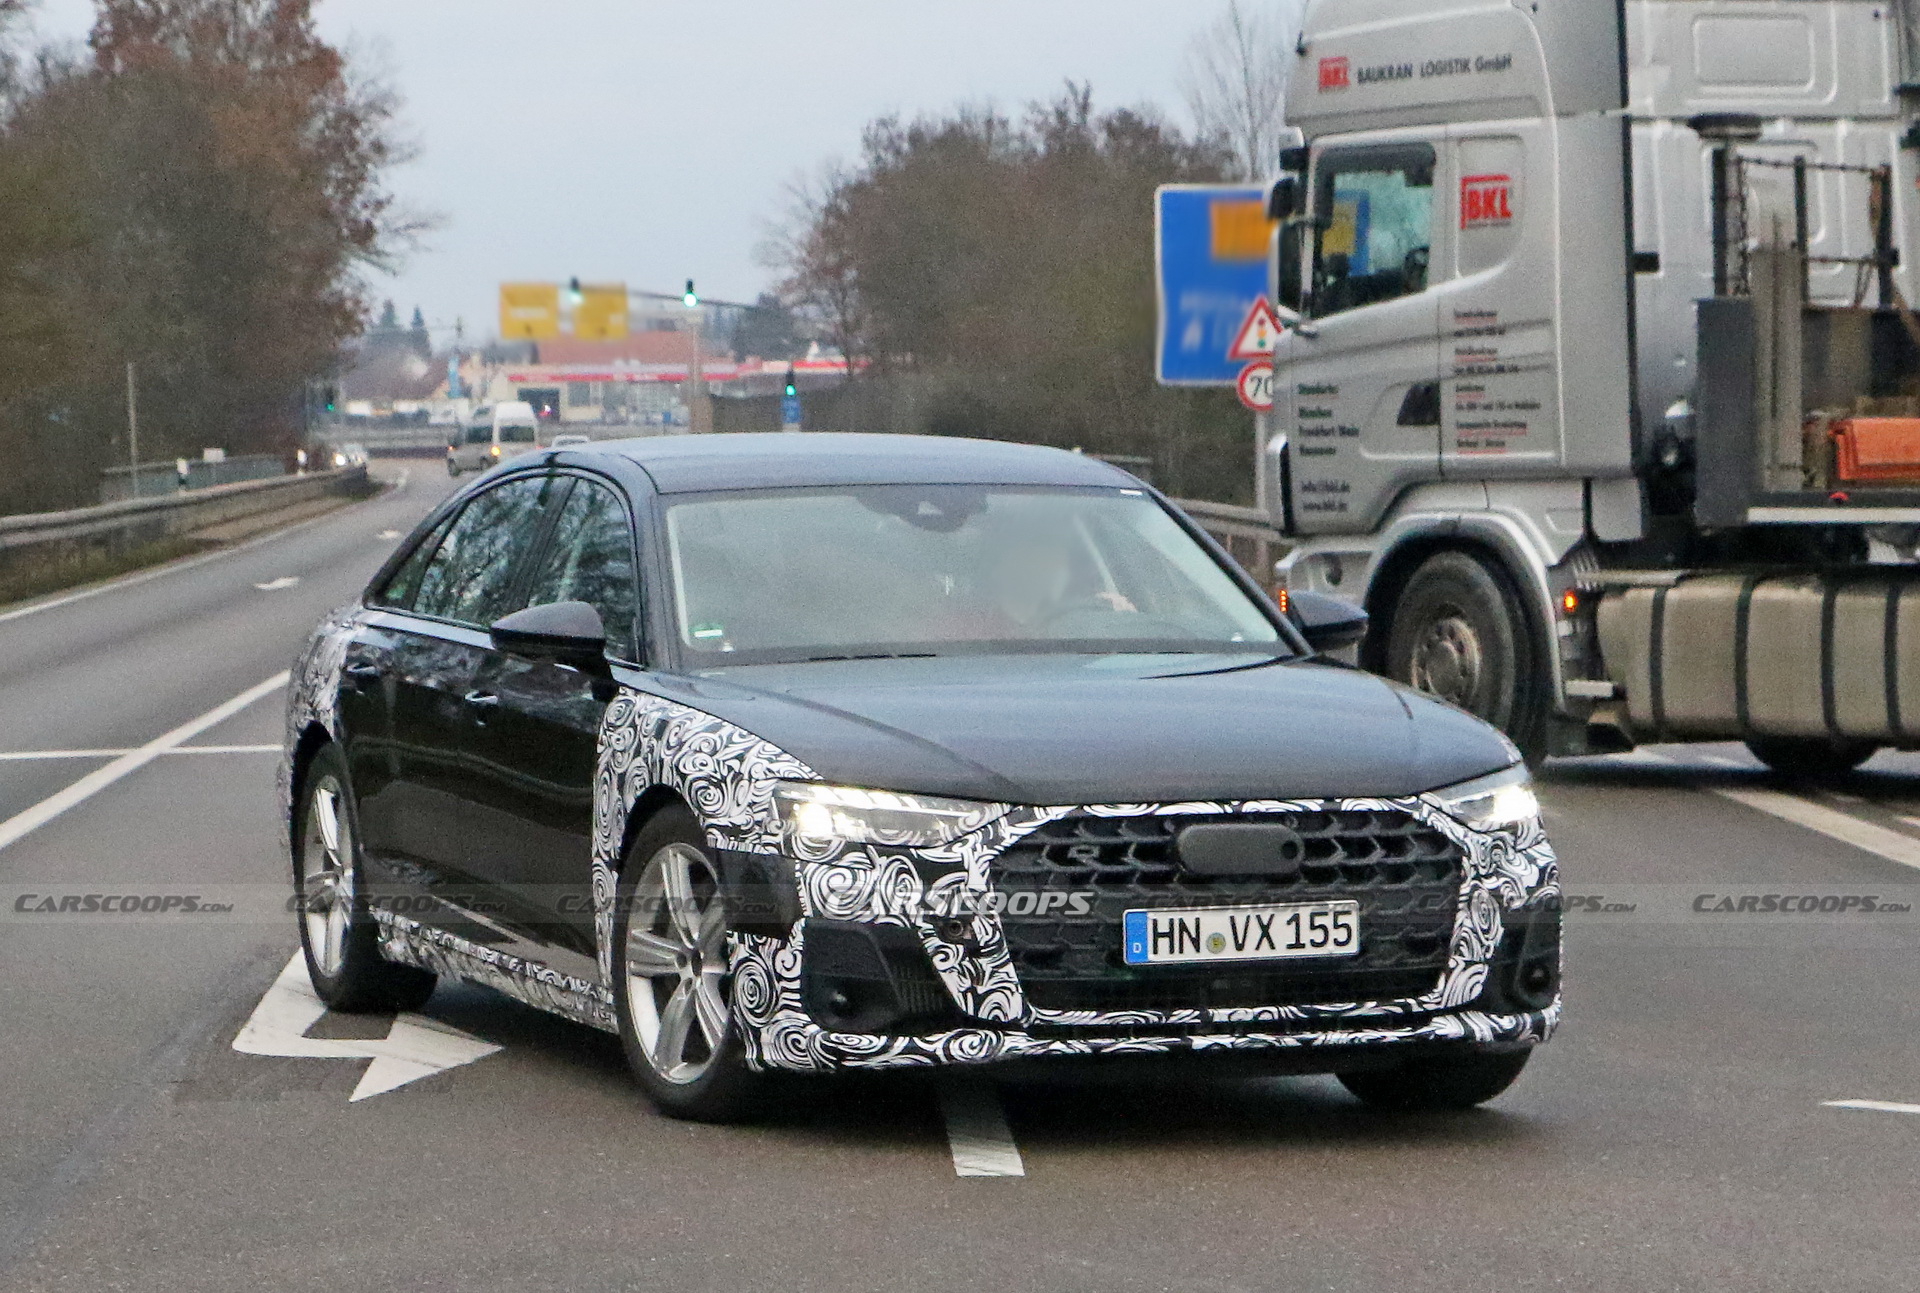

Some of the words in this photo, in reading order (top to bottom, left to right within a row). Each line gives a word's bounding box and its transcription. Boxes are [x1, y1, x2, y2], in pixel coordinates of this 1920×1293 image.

[1357, 63, 1413, 84] BAUKRAN
[1420, 57, 1470, 78] LOGISTIK
[1474, 53, 1512, 72] GmbH
[1467, 187, 1513, 219] BKL
[1132, 942, 1142, 954] D
[1151, 916, 1201, 955] HN
[1229, 913, 1276, 952] VX
[1285, 910, 1353, 950] 155
